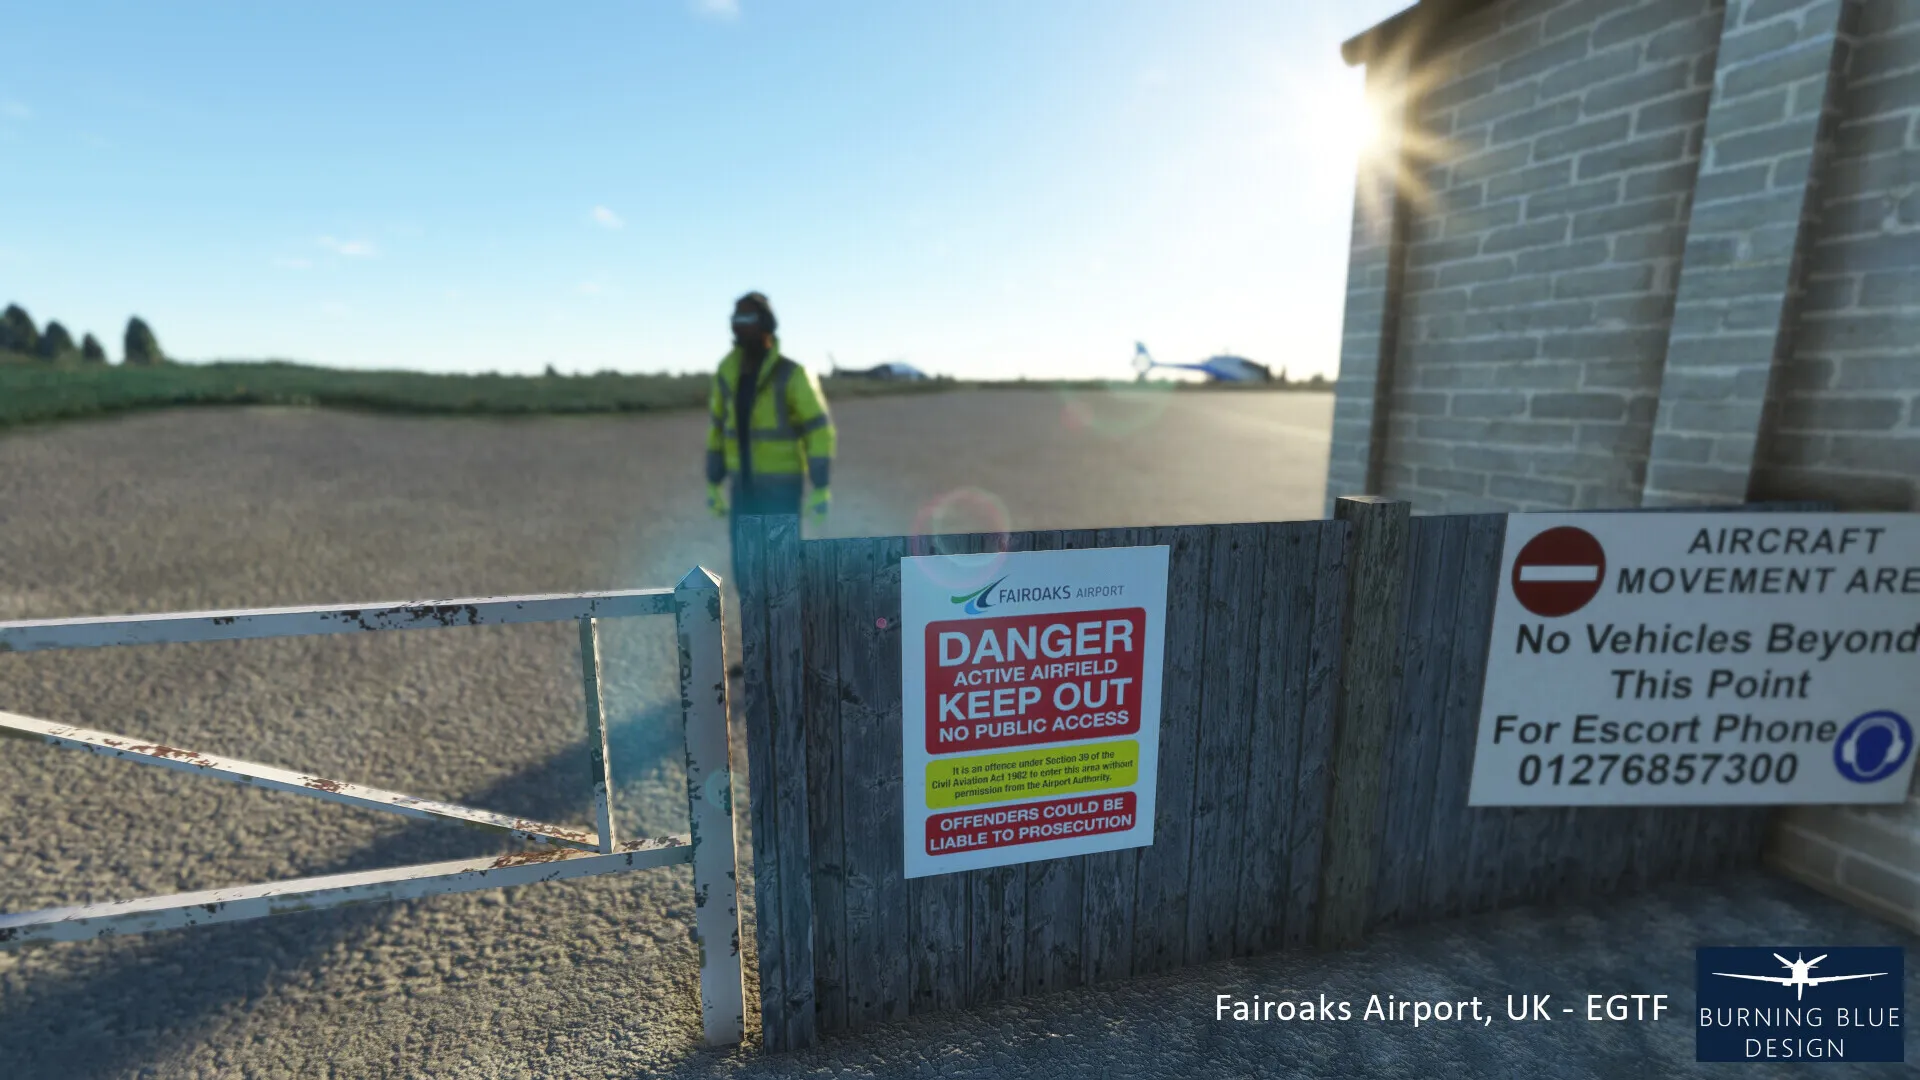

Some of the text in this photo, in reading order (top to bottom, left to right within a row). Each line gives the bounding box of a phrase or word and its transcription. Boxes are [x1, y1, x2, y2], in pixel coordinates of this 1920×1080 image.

[1687, 527, 1886, 555] AIRCRAFT
[999, 585, 1125, 604] FAIROAKS AIRPORT
[1616, 567, 1836, 594] MOVEMENT
[938, 619, 1134, 667] DANGER
[1515, 622, 1920, 661] No Vehicles Beyond
[953, 659, 1118, 687] ACTIVE AIRFIELD
[1610, 668, 1812, 700] This Point
[939, 677, 1133, 723] KEEP OUT
[939, 710, 1130, 743] NO PUBLIC ACCESS
[1493, 713, 1838, 745] For Escort Phone
[931, 779, 951, 789] Civil
[953, 776, 988, 787] Aviation
[990, 773, 1004, 782] Act
[1040, 767, 1062, 777] enter
[1064, 765, 1080, 774] this
[1082, 764, 1100, 772] area
[1102, 760, 1133, 770] without
[953, 767, 959, 775] It
[961, 767, 969, 775] is
[984, 762, 1016, 772] offence
[1018, 758, 1044, 768] under
[1045, 755, 1077, 765] Section
[1078, 753, 1089, 761] 39
[1091, 752, 1100, 760] of
[1101, 751, 1115, 759] the
[1518, 752, 1800, 787] 01276857300
[954, 773, 1112, 799] permission from the Airport Authority.
[940, 797, 1124, 832] OFFENDERS COULD BE
[930, 813, 1132, 852] LIABLE TO PROSECUTION
